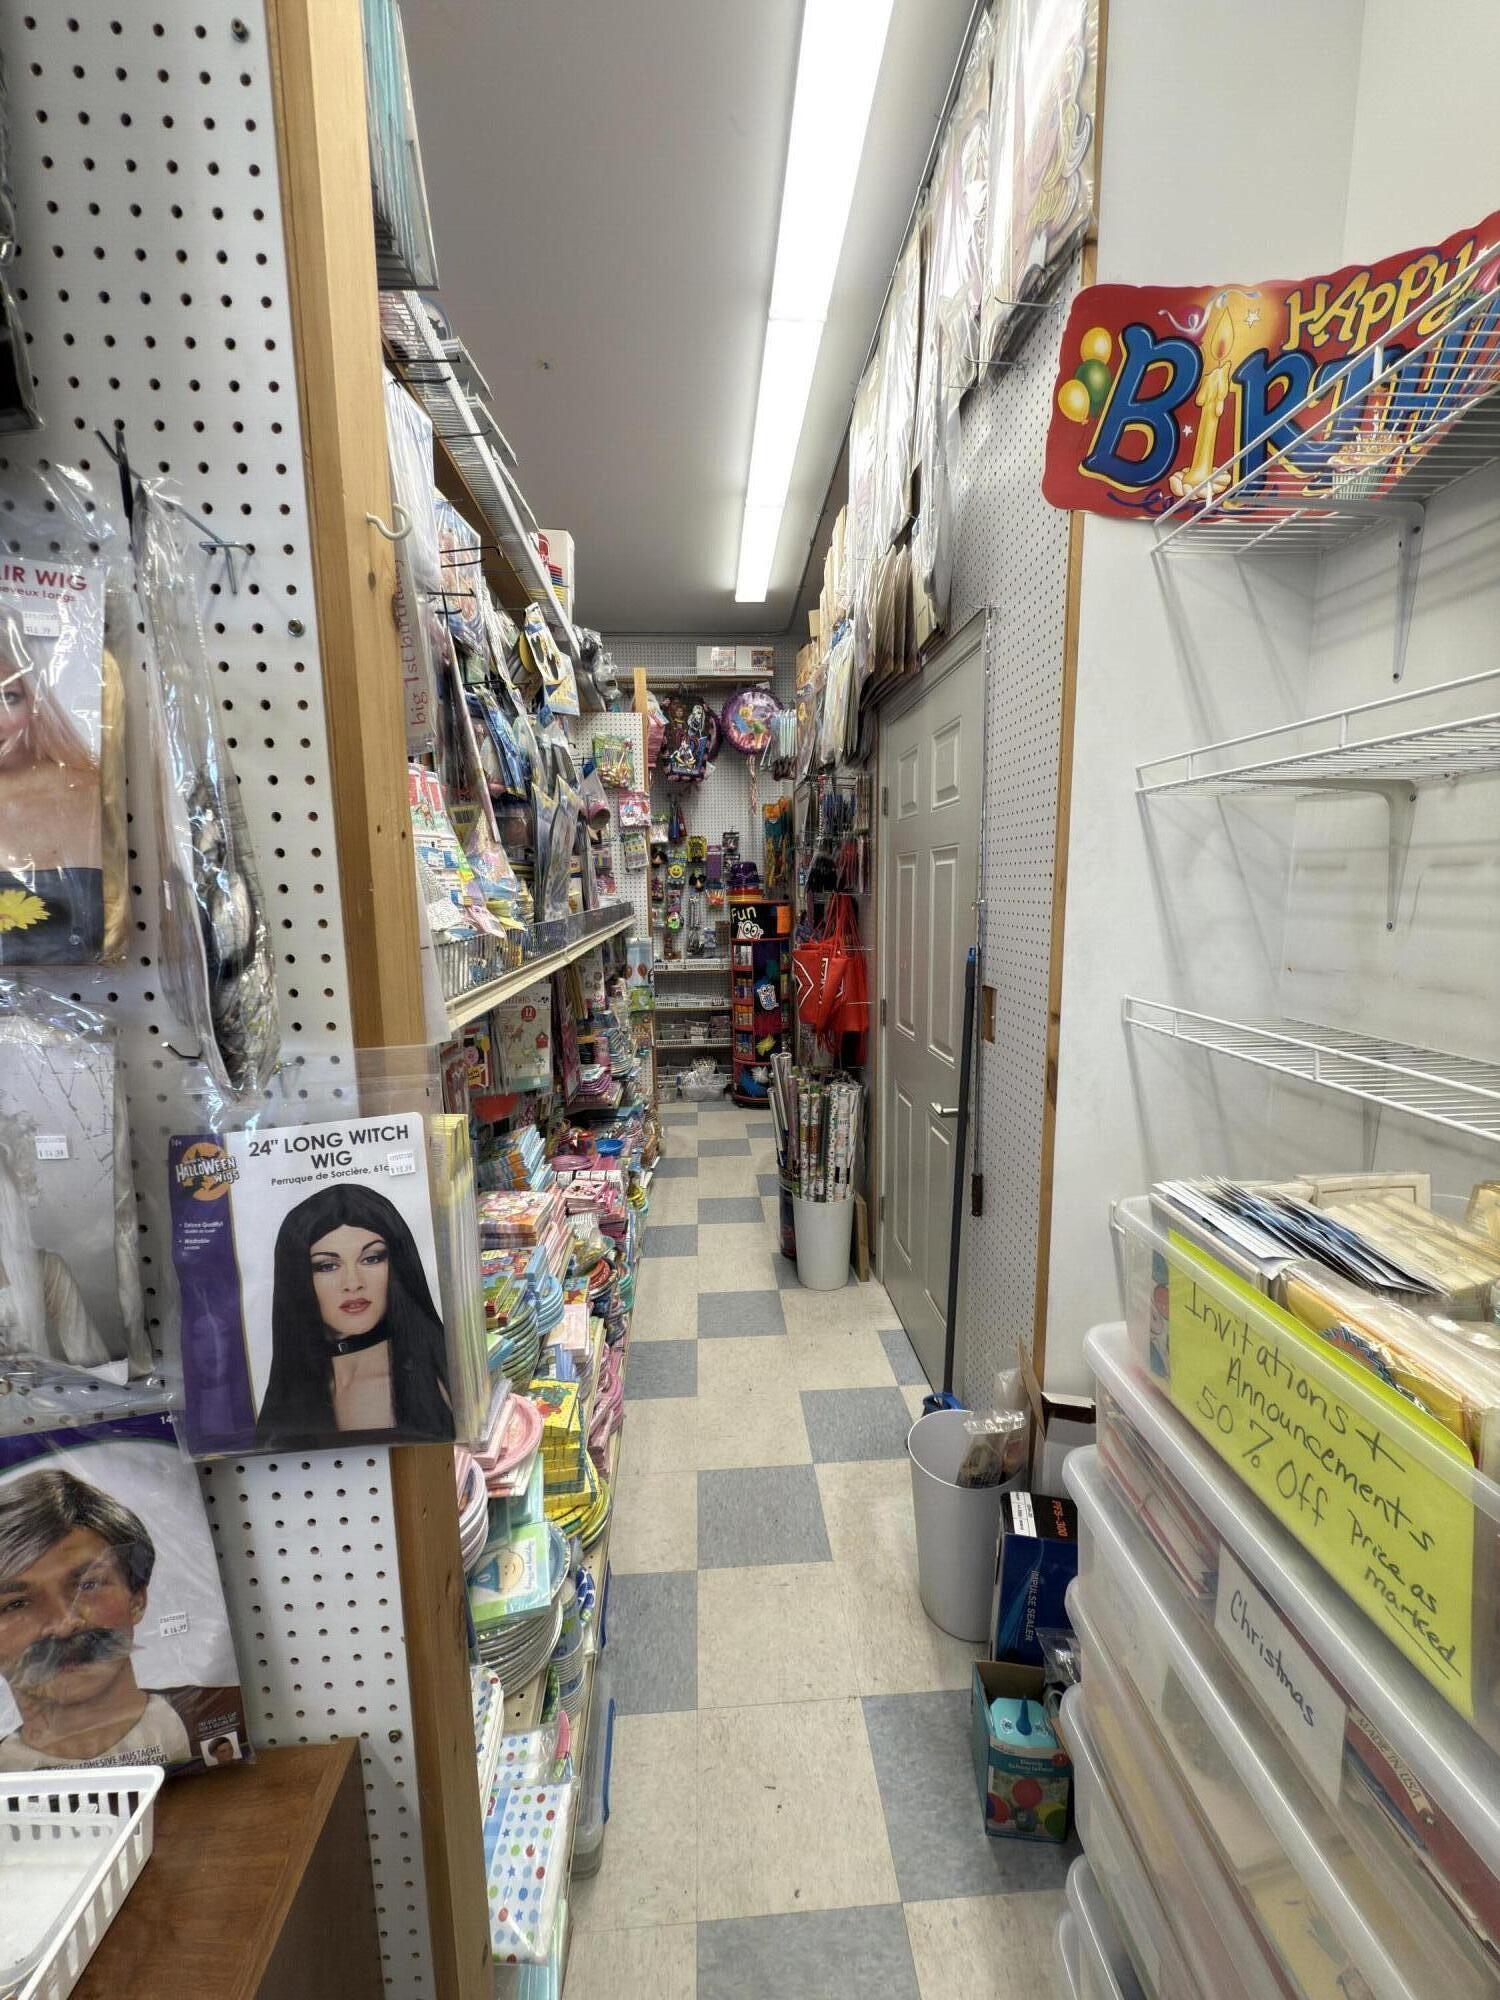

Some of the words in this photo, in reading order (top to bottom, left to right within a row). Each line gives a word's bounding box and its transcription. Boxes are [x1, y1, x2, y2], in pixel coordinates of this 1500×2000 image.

[35, 568, 88, 591] WIG
[411, 691, 428, 727] big
[248, 1138, 279, 1158] 24"
[284, 1132, 344, 1154] LONG
[349, 1124, 410, 1146] WITCH
[175, 1156, 238, 1184] HALLOWEEN
[311, 1150, 353, 1170] WIG
[271, 1174, 313, 1187] Perruque
[315, 1172, 329, 1181] de
[1184, 1280, 1350, 1436] Invitations
[1227, 1357, 1436, 1553] Announcements
[1027, 1570, 1040, 1607] IMPULSE
[1410, 1583, 1438, 1614] as
[1024, 1608, 1037, 1642] SEALER
[1364, 1566, 1463, 1678] marked
[1230, 1589, 1315, 1728] Christmas
[119, 1745, 162, 1763] MUSTACHE
[1400, 1772, 1422, 1800] USA
